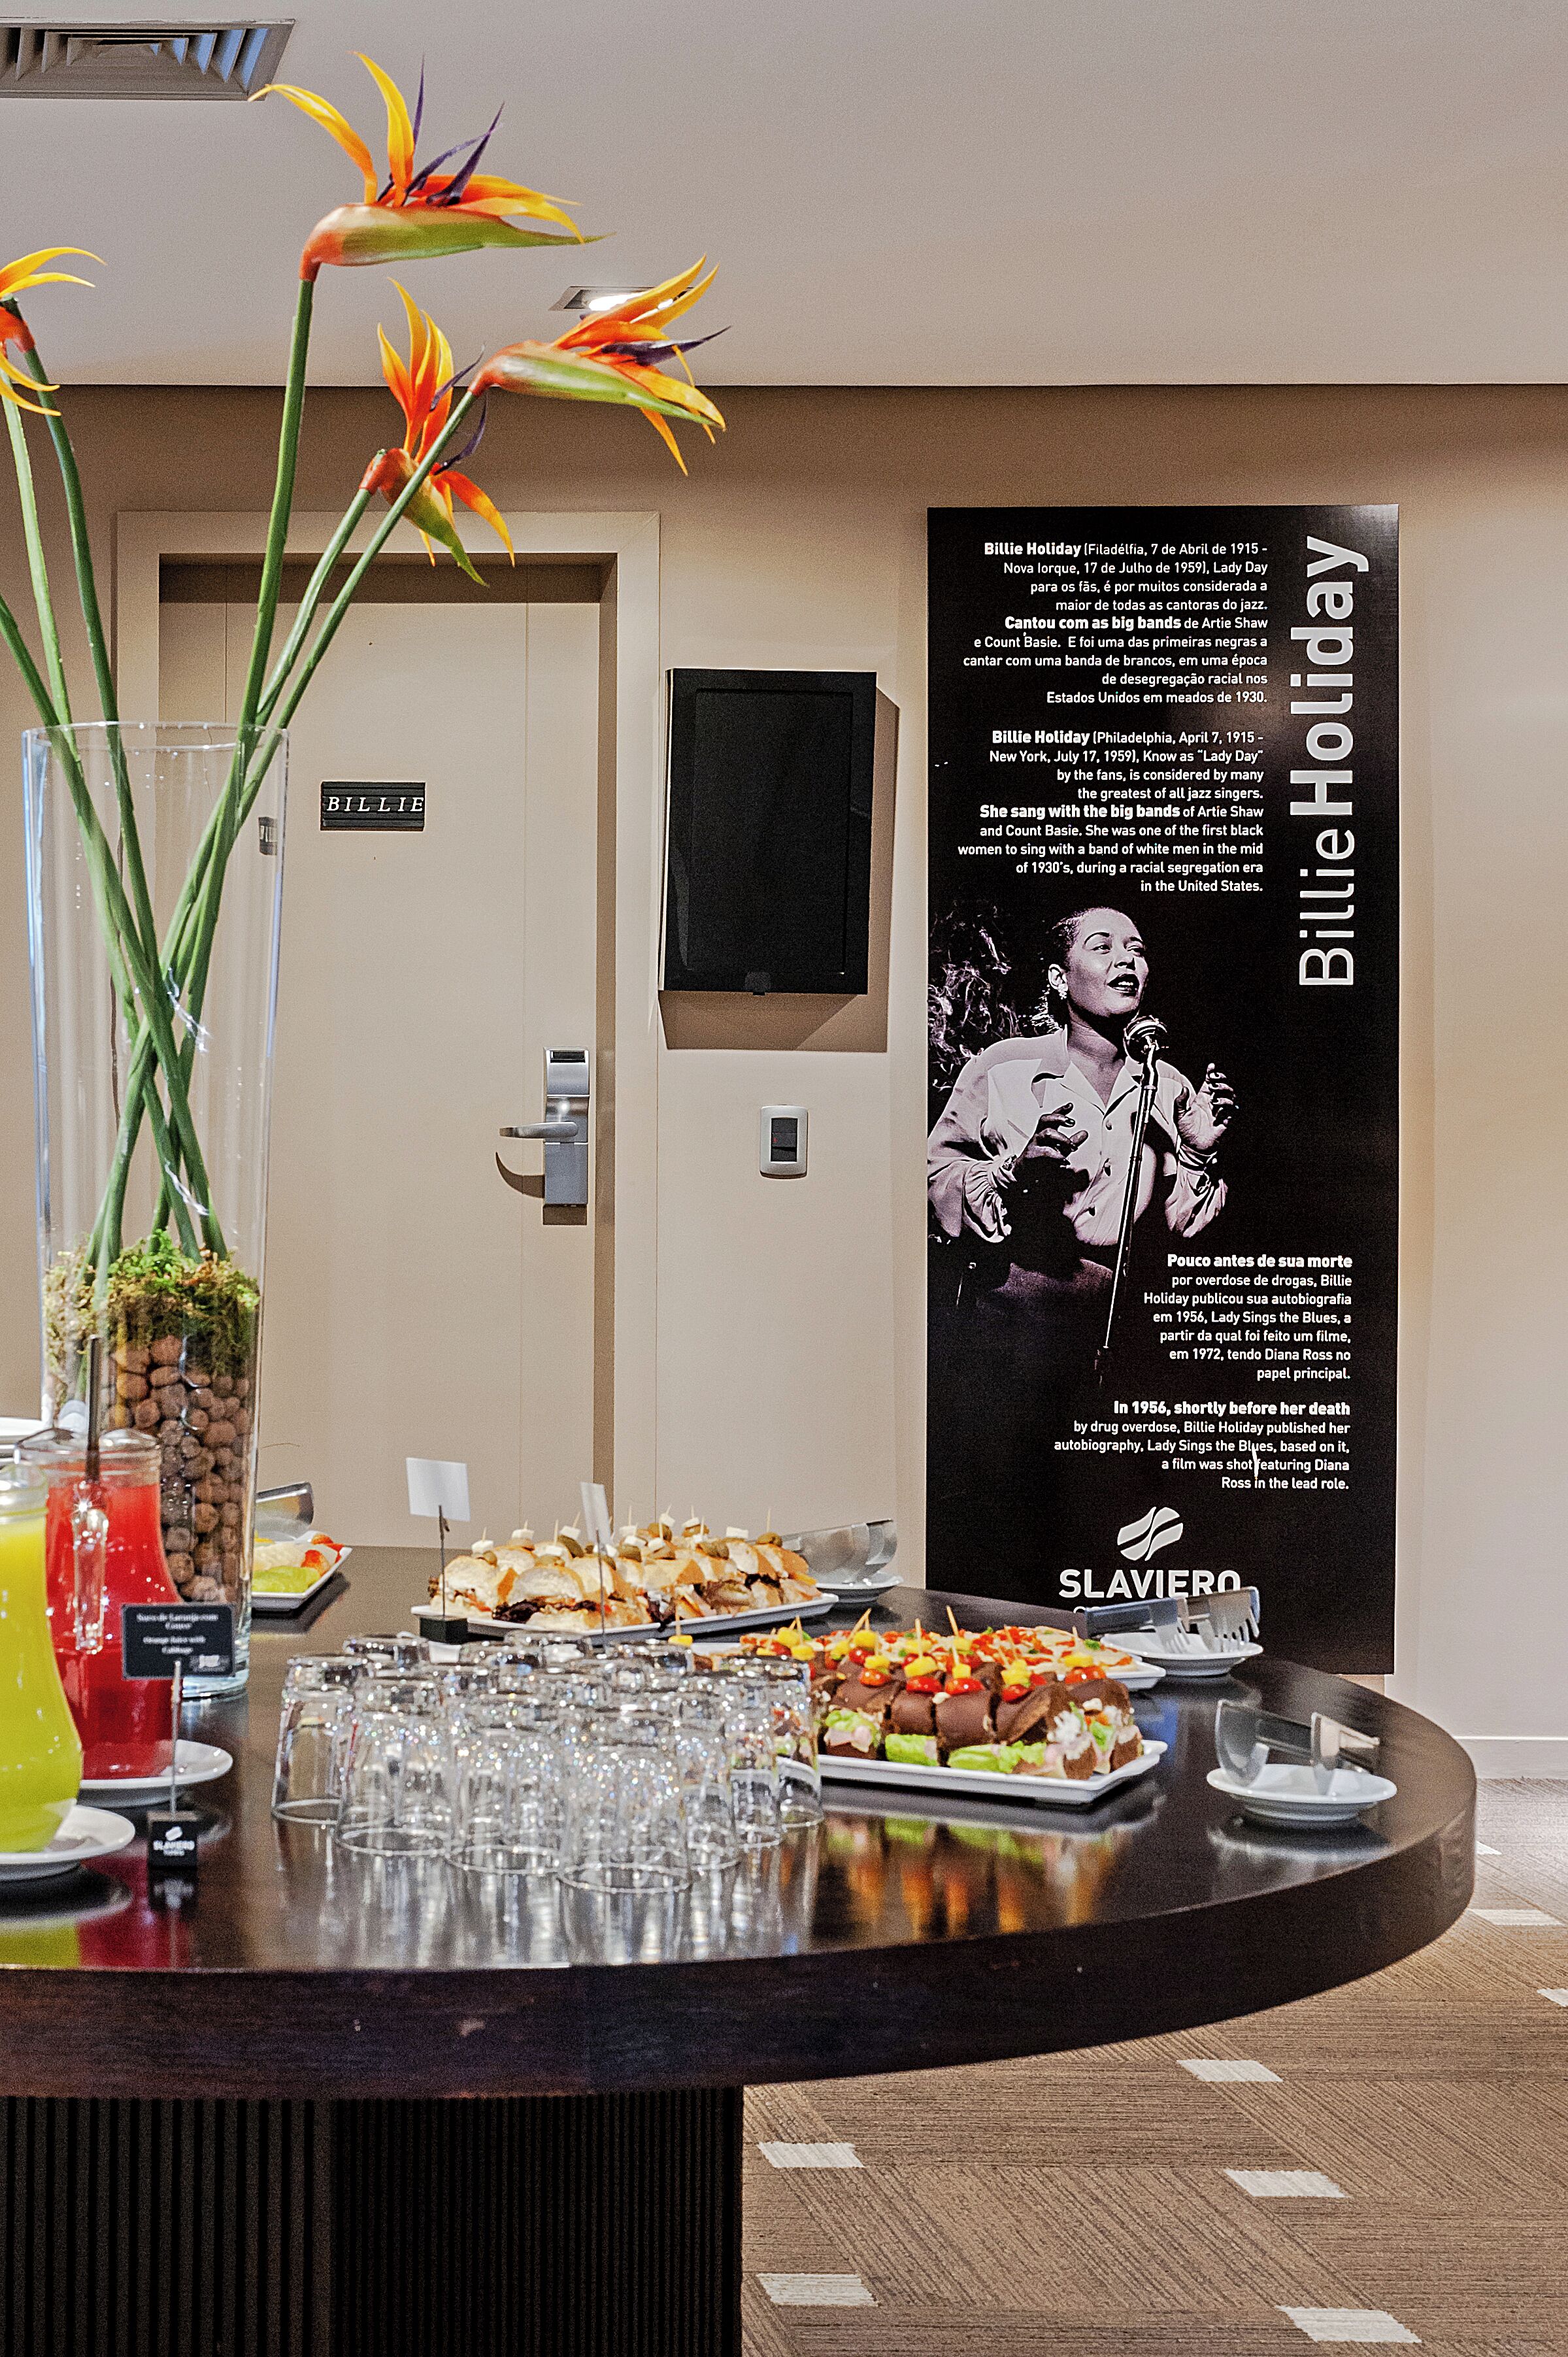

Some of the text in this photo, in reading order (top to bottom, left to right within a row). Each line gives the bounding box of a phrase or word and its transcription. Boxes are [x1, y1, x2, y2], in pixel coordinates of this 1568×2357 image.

[984, 542, 1259, 558] Billie Holiday (Filadélfia, 7 de Abril de 1915
[1004, 560, 1268, 577] Nova Iorque, 17 de Julho de 1959), Lady Day
[1056, 598, 1268, 613] maior de todas as cantoras do jazz.
[1005, 616, 1268, 631] Cantou com as big bands de Artie Shaw
[1101, 672, 1268, 688] de desegregação racial nos
[1046, 690, 1267, 703] Estados Unidos em meados de 1930.
[992, 729, 1255, 746] Billie Holiday (Philadelphia, April 7, 1915
[1290, 535, 1369, 985] Billie Holiday
[1057, 768, 1265, 784] by the fans, is considered by many
[1077, 786, 1263, 802] the greatest of all jazz singers.
[326, 796, 424, 812] BILLIE
[979, 804, 1264, 820] She sang with the big bands of Artie Shaw
[1016, 861, 1029, 873] of
[1076, 861, 1116, 877] during
[1119, 864, 1127, 873] a
[1130, 861, 1165, 873] racial
[1167, 861, 1240, 876] segregation
[1243, 863, 1263, 873] era
[1141, 879, 1263, 892] in the United States.
[1167, 1254, 1353, 1268] Pouco antes de sua morte
[1172, 1273, 1352, 1289] por overdose de drogas, Billie
[1144, 1292, 1352, 1308] Holiday publicou sua autobiografia
[1153, 1311, 1352, 1326] em 1956, Lady Sings the Blues, a
[1169, 1348, 1351, 1362] em 1972, tendo Diana Ross no
[1257, 1367, 1351, 1382] papel principal.
[1114, 1400, 1350, 1417] In 1956, shortly before her death
[1074, 1420, 1351, 1436] by drug overdose, Billie Holiday published her
[1054, 1439, 1351, 1455] autobiography, Lady Sings the Blues, based on it,
[1222, 1477, 1349, 1490] Ross in the lead role.
[1059, 1569, 1241, 1599] SLAVIERO
